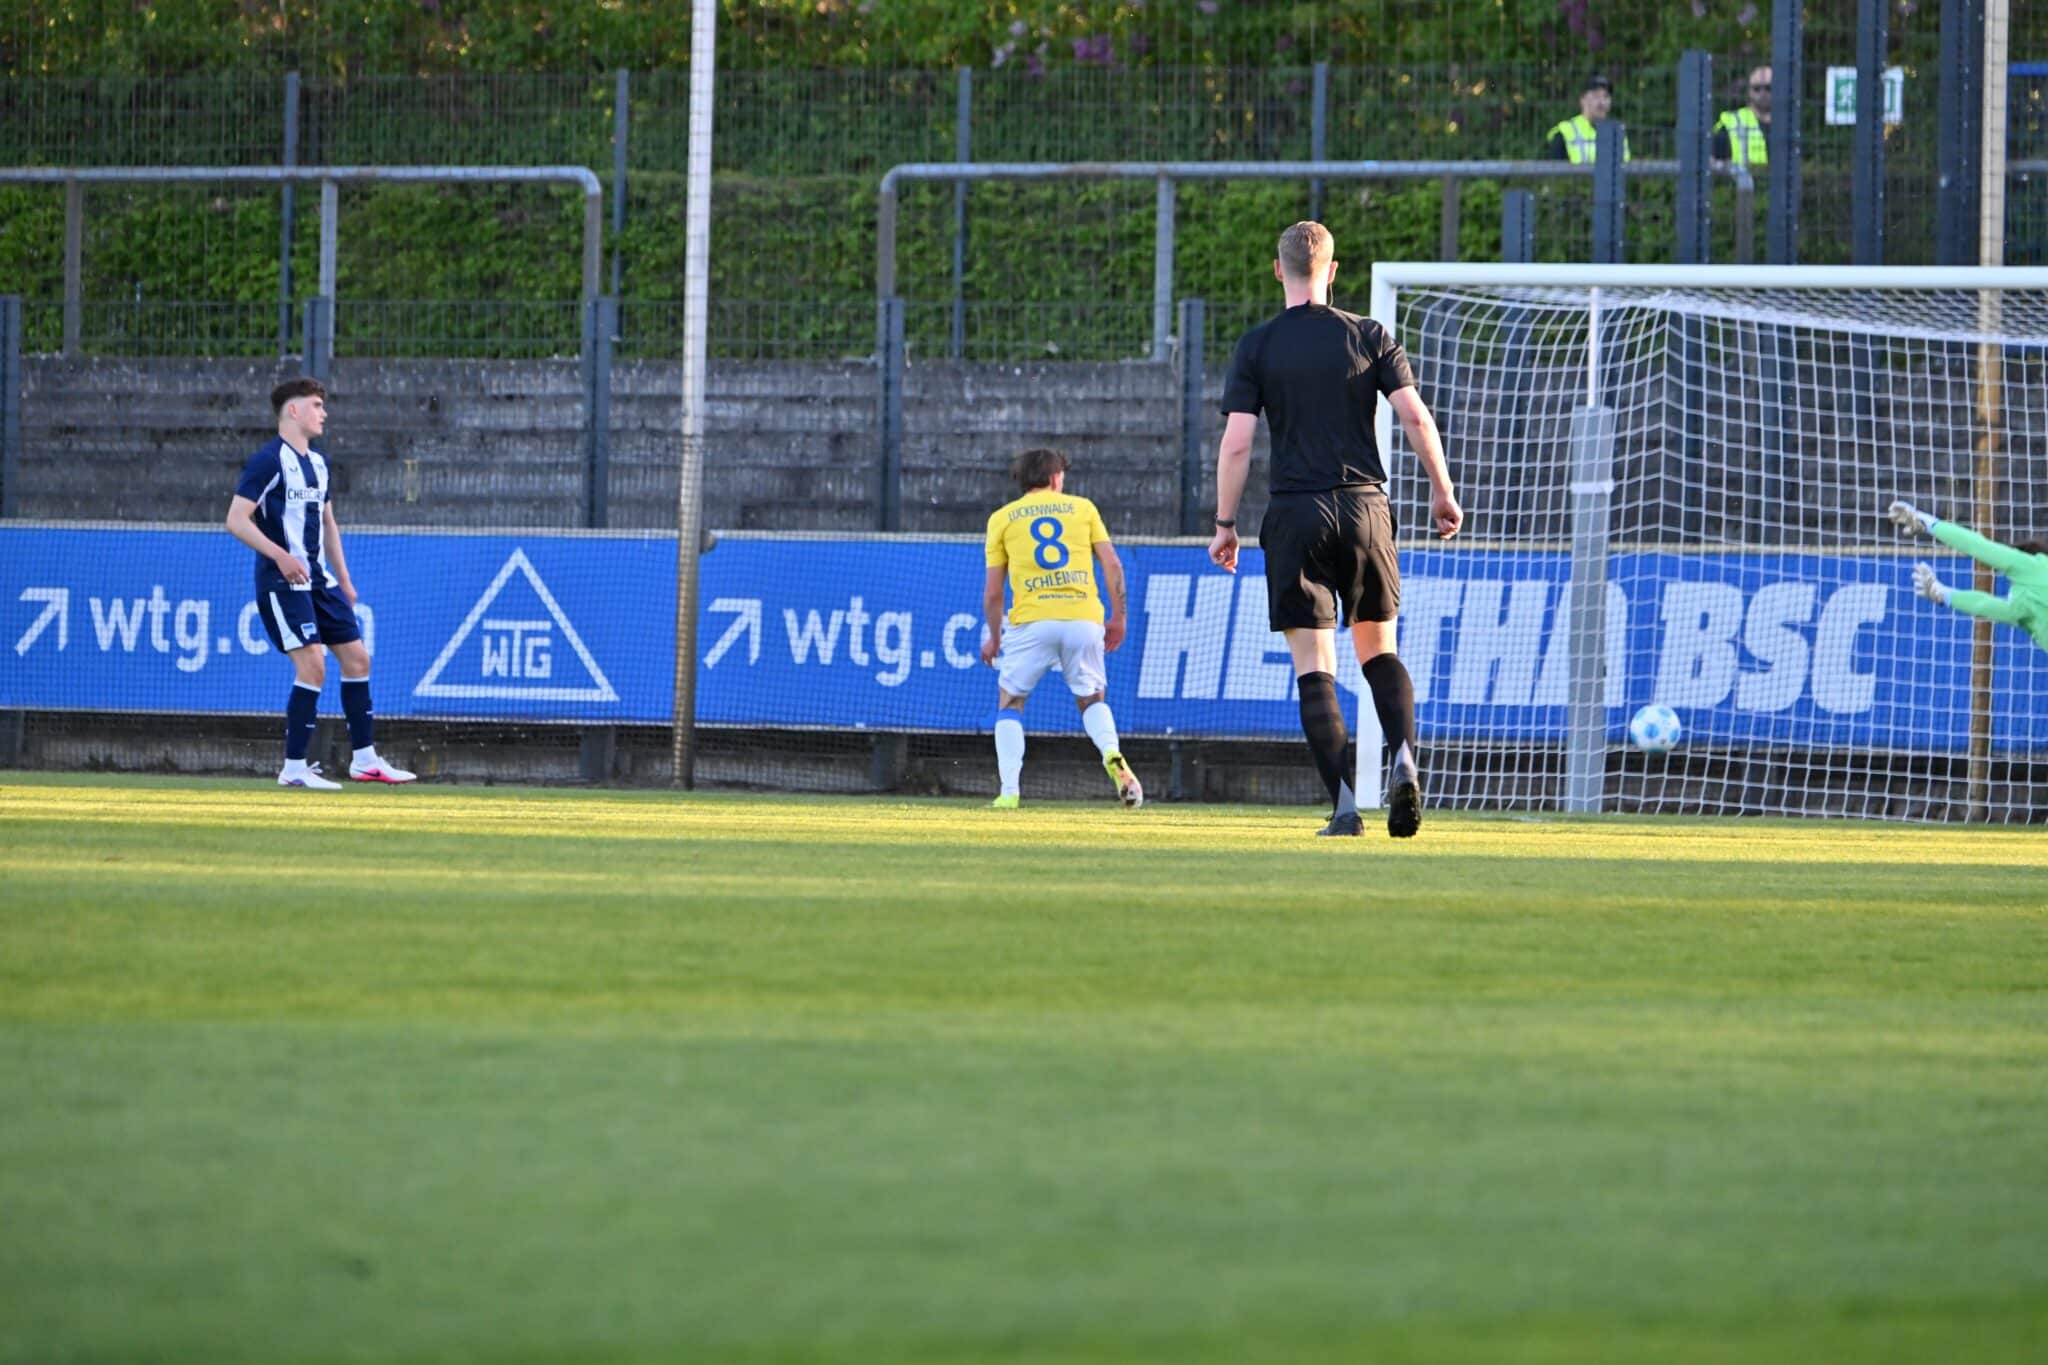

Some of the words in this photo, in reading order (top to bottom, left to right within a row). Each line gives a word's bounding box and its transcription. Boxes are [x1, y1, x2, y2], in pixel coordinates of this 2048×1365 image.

[1008, 504, 1074, 521] LUCKENWALDE
[1030, 516, 1070, 570] 8
[1025, 570, 1089, 591] SCHLEINITZ
[482, 618, 552, 679] WTG
[1138, 573, 1626, 708] HETHA
[1656, 581, 1888, 714] BSC
